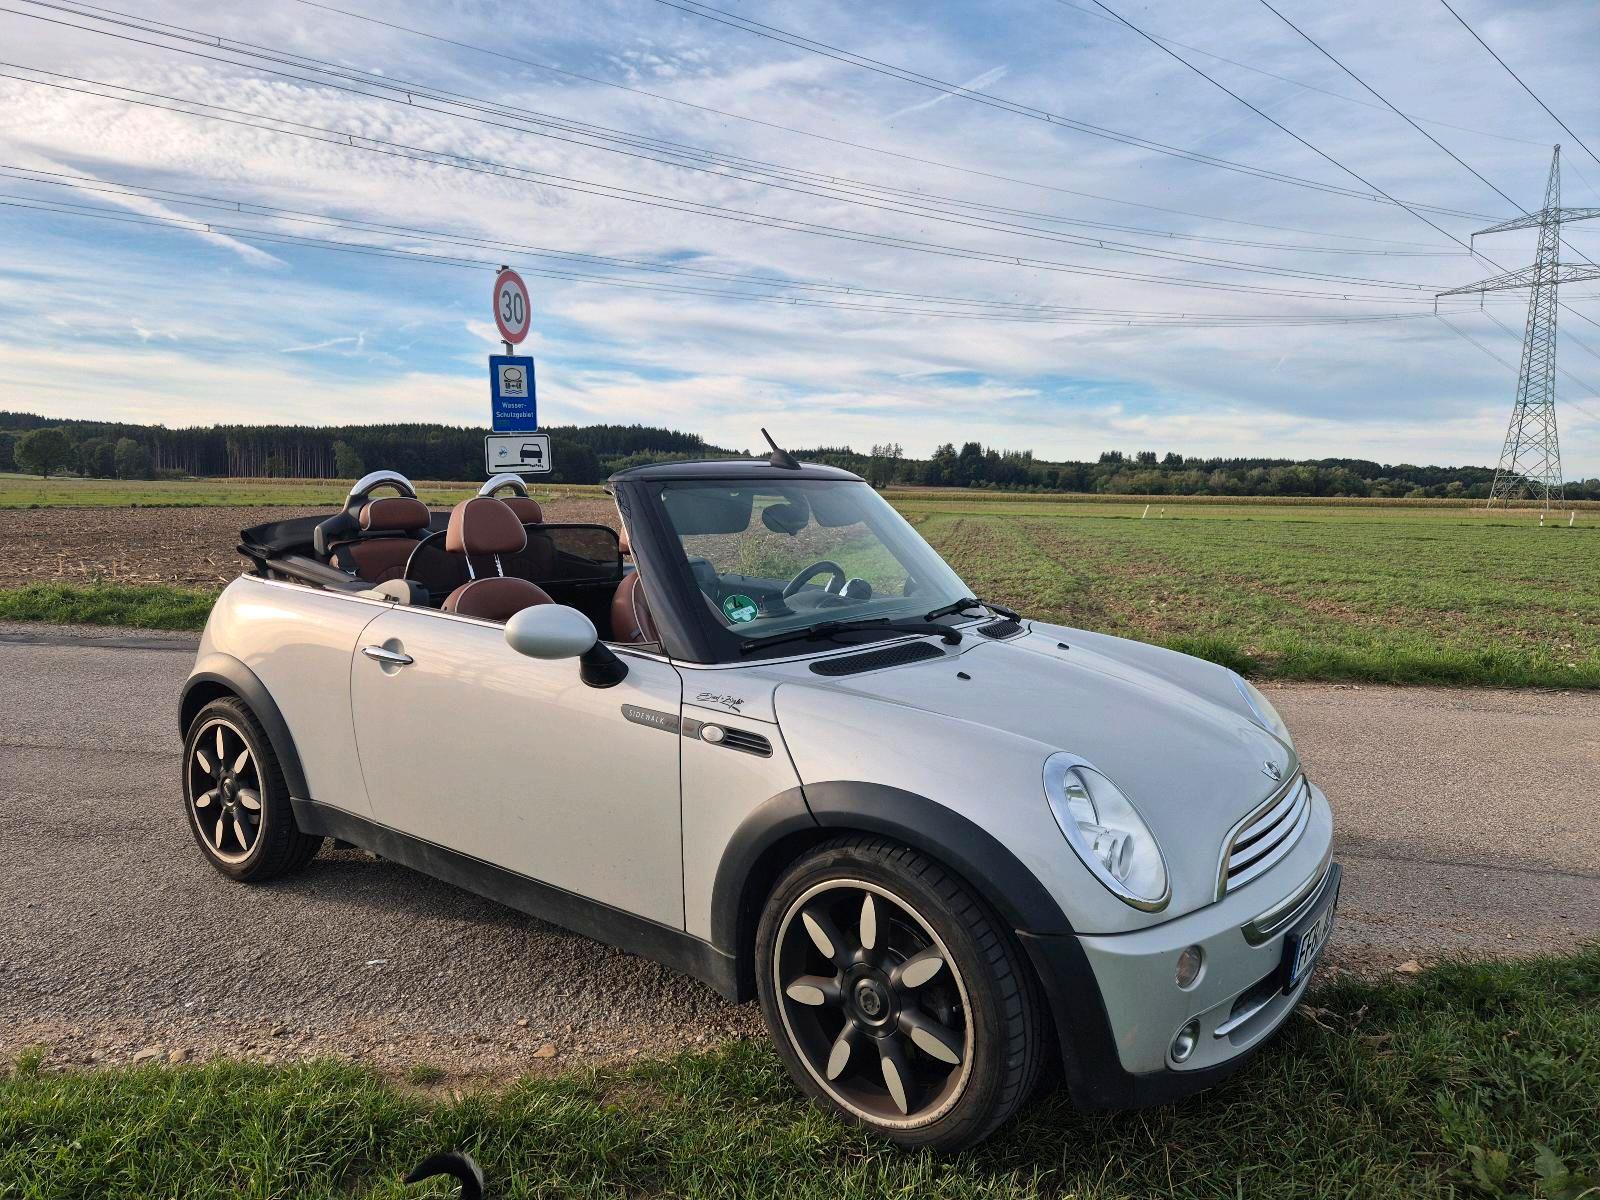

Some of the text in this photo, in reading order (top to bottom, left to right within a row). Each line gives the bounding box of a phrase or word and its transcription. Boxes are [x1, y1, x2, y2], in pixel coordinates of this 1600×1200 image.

[502, 290, 523, 324] 30
[501, 401, 527, 409] Wasser-
[495, 411, 534, 419] Schutzgebiet
[628, 709, 665, 725] SIDEWALK
